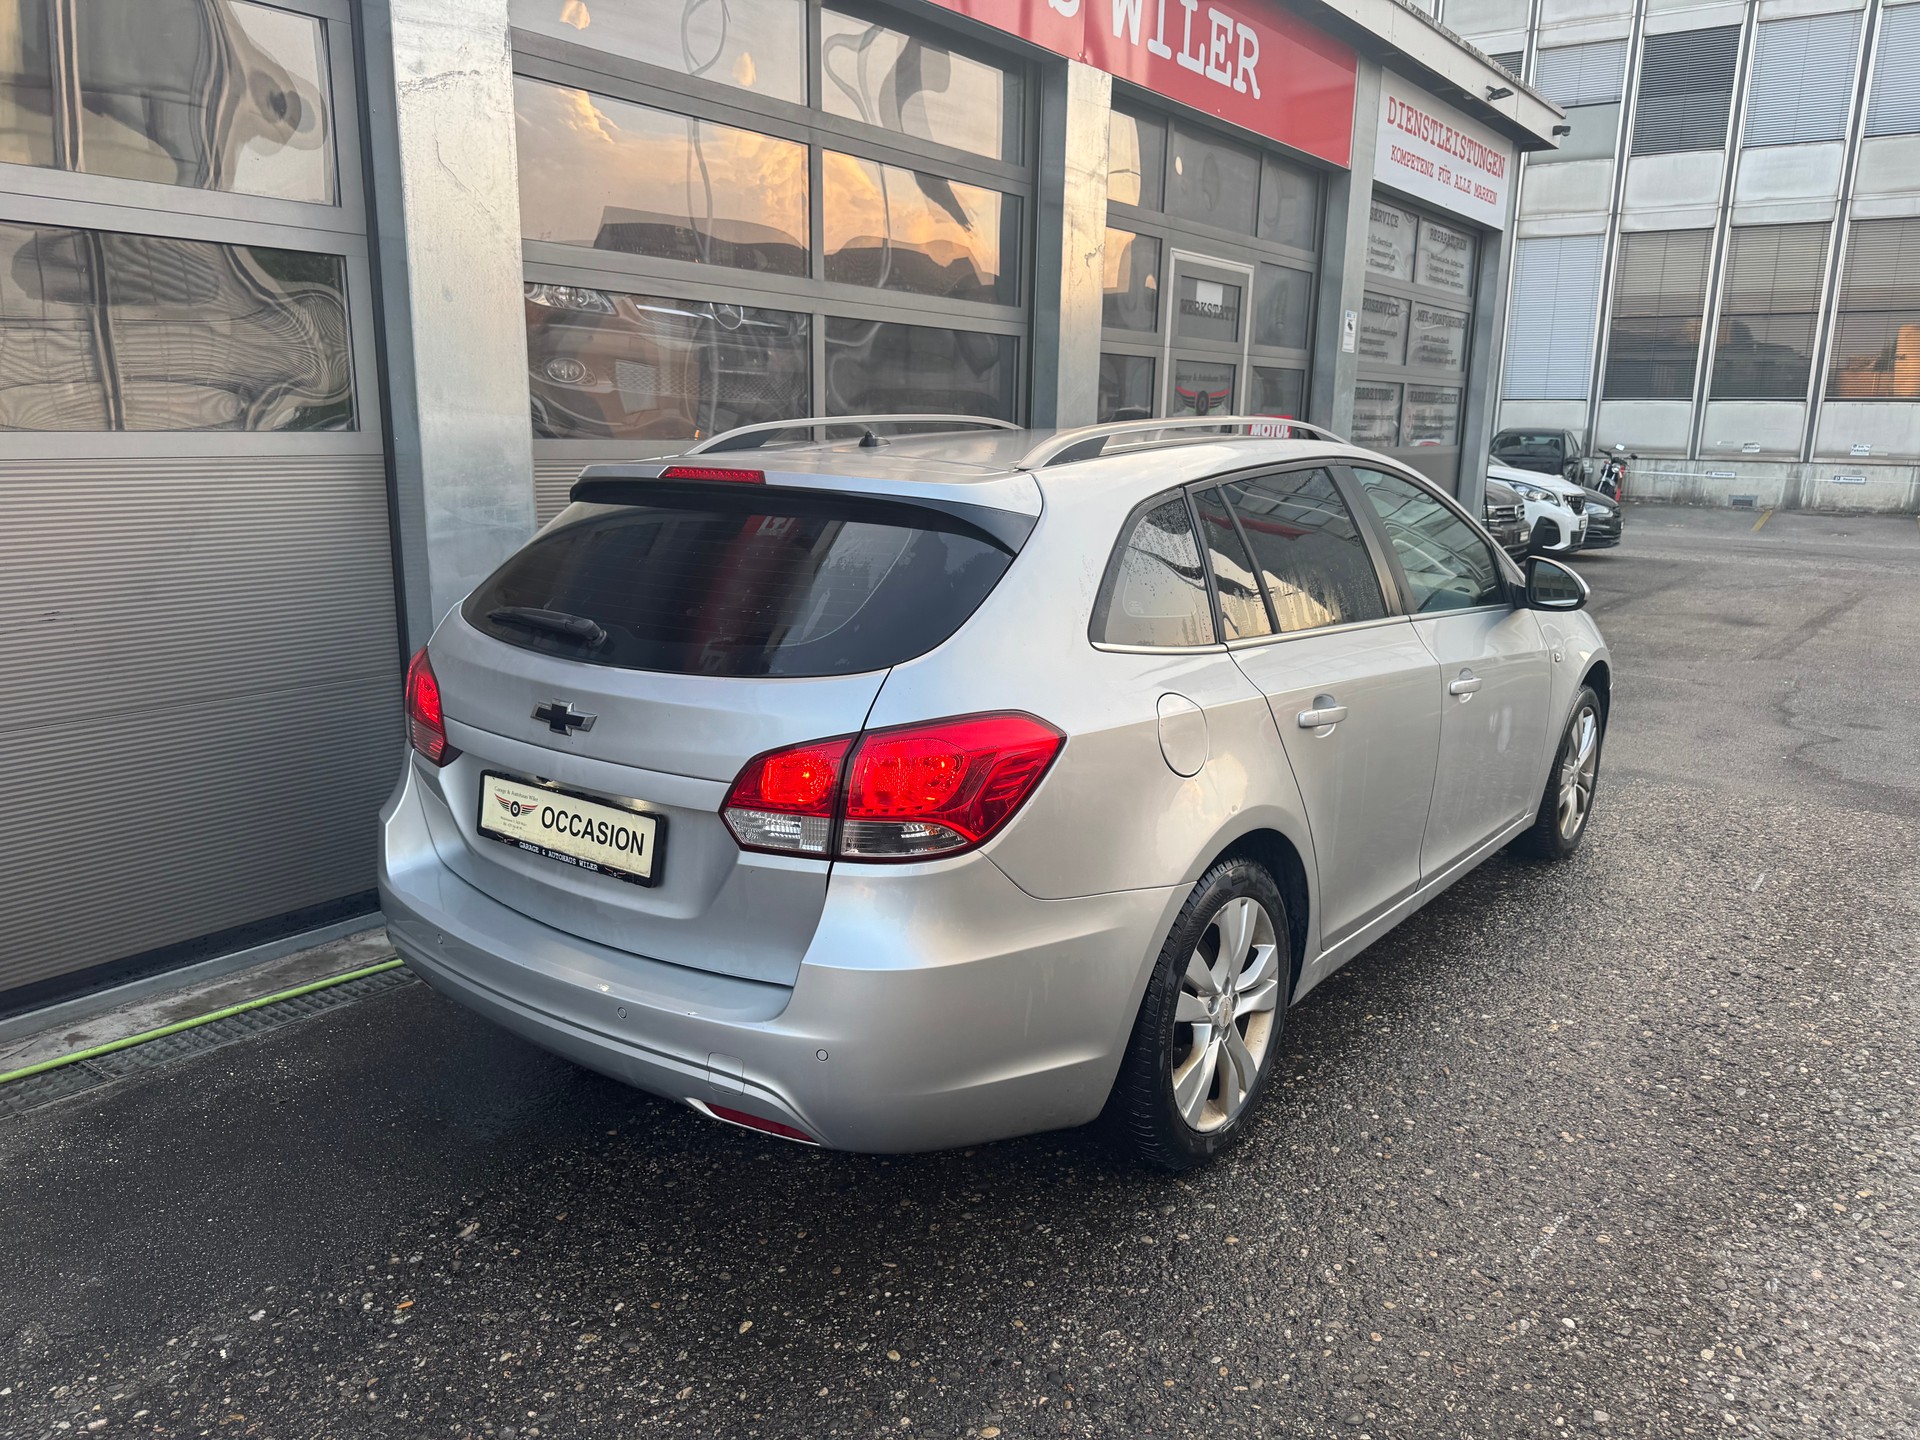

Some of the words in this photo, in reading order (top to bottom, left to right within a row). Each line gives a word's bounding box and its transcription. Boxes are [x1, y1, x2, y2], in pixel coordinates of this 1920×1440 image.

[1111, 0, 1261, 100] WILER
[1387, 96, 1506, 179] DIENSTLEISTUNGEN
[1391, 145, 1434, 178] KOMPETENZ
[1438, 165, 1452, 185] FÜR
[1454, 174, 1471, 195] ALLE
[1474, 183, 1497, 205] MARKEN
[1370, 207, 1399, 228] SERVICE
[1180, 299, 1236, 321] WERKSTATT
[1250, 424, 1291, 438] MOTUL
[541, 806, 645, 856] OCCASION
[519, 841, 540, 853] GARAGE
[548, 850, 576, 864] AUTOHAUS
[579, 860, 598, 871] WILER
